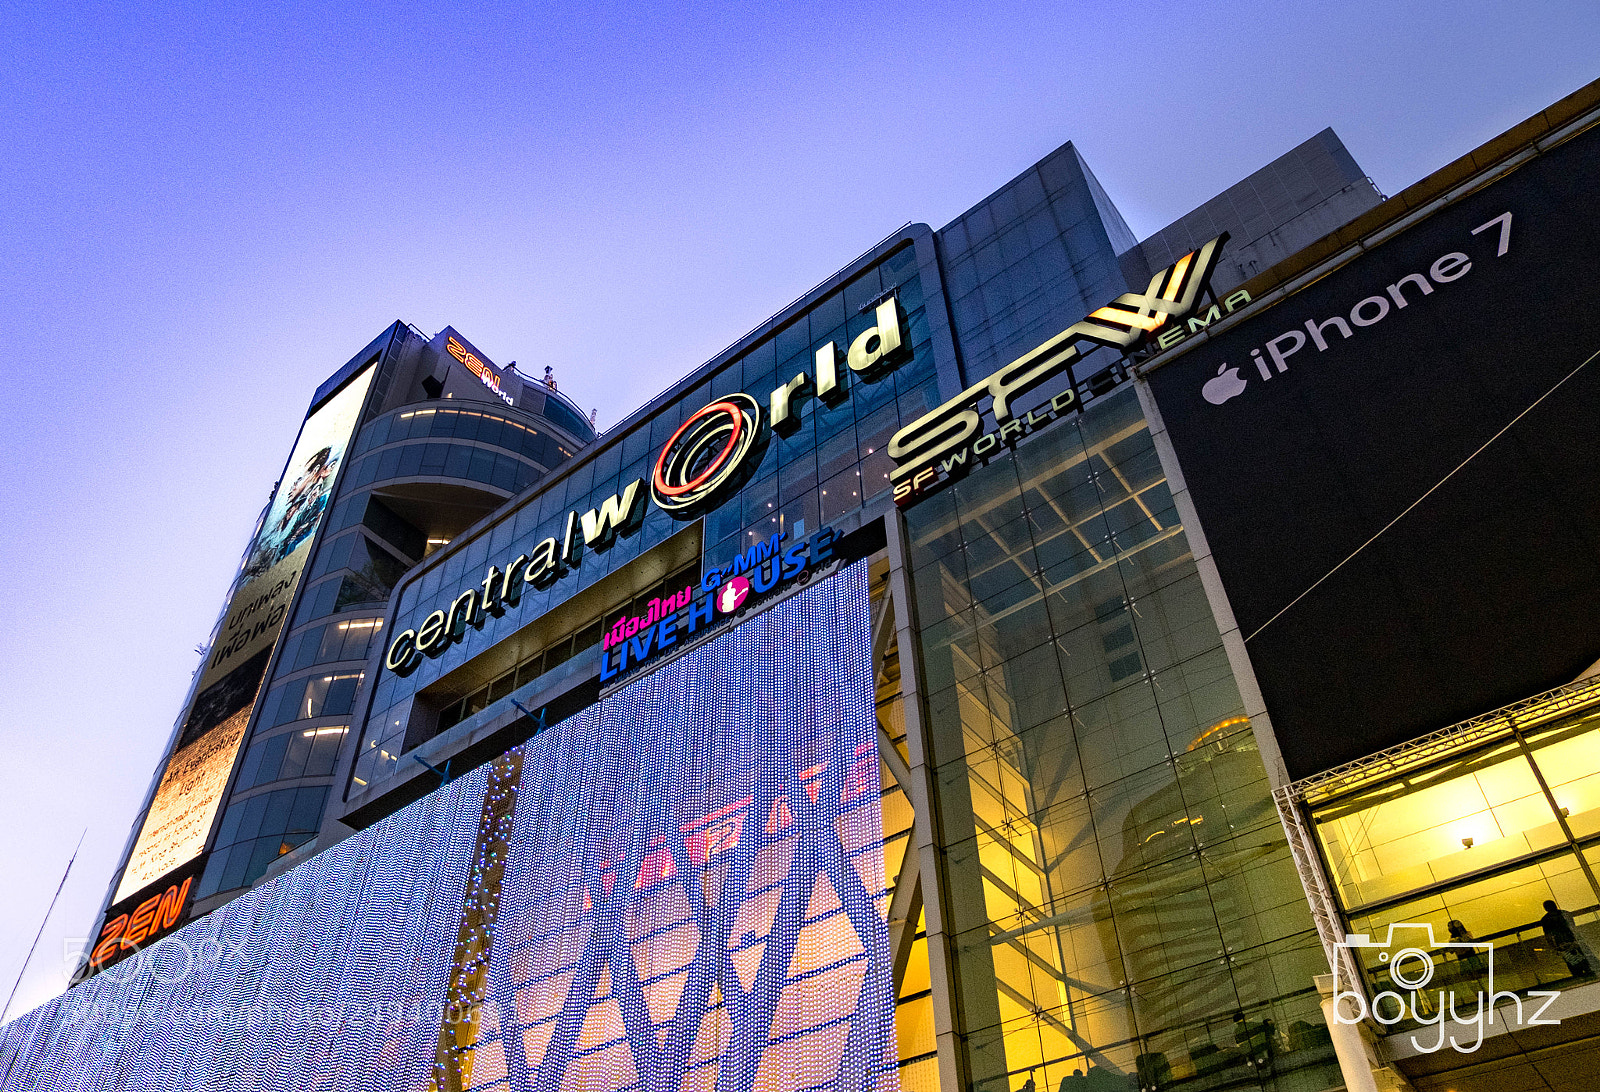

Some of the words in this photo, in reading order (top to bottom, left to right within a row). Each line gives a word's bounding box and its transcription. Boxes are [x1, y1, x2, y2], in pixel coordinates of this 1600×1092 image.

[1250, 251, 1473, 381] iPhone
[1470, 211, 1513, 257] 7
[446, 335, 501, 389] ZEN
[480, 372, 514, 406] World
[892, 466, 935, 502] SF
[940, 387, 1076, 472] WORLD
[600, 613, 680, 683] LIVE
[603, 585, 692, 651] เมืองไทย
[89, 875, 194, 967] ZEN
